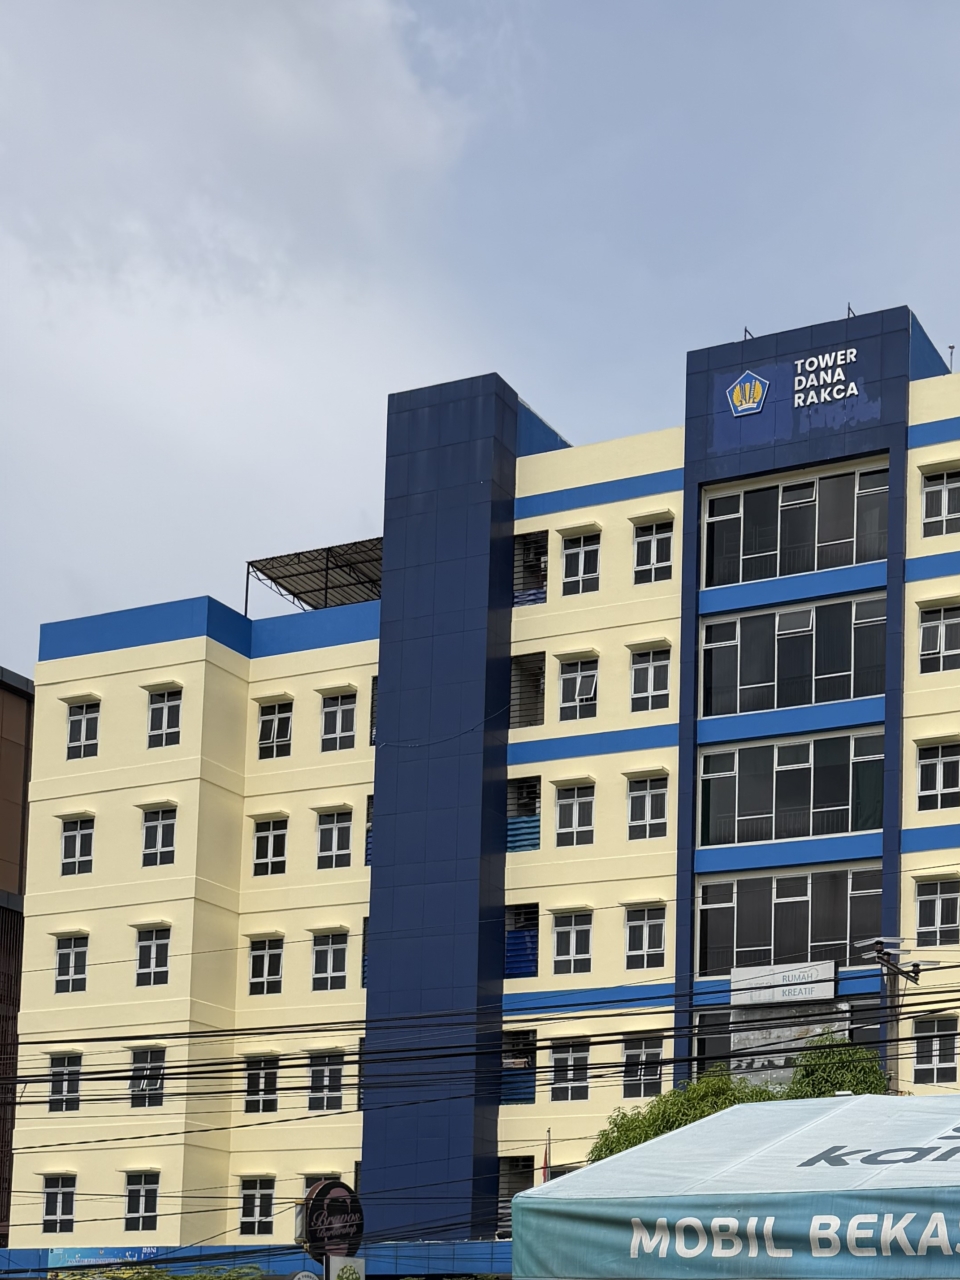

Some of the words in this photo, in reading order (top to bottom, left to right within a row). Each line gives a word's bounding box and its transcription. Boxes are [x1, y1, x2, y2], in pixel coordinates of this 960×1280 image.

[794, 348, 857, 374] TOWER
[794, 366, 846, 391] DANA
[794, 382, 859, 408] RAKCA
[782, 973, 813, 983] RUMAH
[782, 987, 816, 997] KREATIF
[630, 1216, 793, 1259] MOBIL
